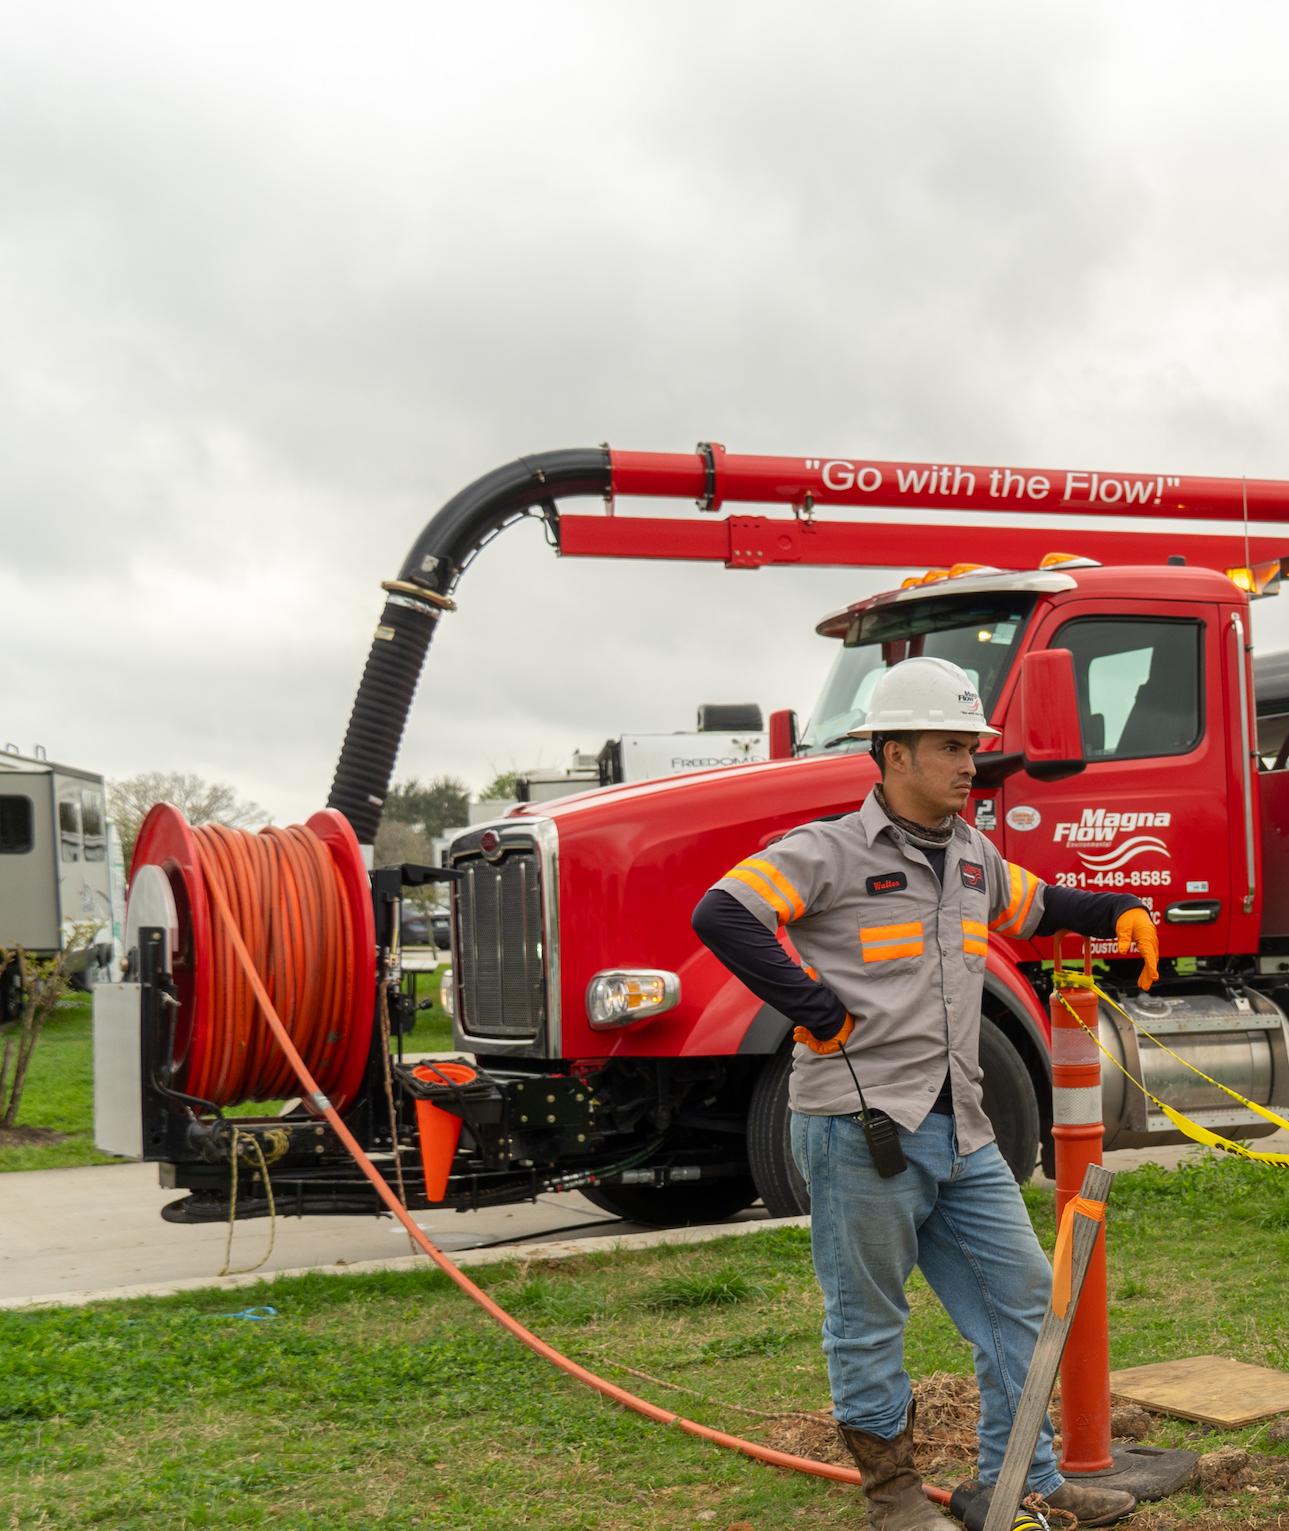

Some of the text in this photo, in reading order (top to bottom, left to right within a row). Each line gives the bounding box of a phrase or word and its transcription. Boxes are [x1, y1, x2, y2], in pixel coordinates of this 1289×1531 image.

[804, 459, 1181, 506] "Go with the Flow!"
[1080, 808, 1172, 832] Magna
[1053, 822, 1118, 842] Flow
[1055, 870, 1172, 888] 281-448-8585
